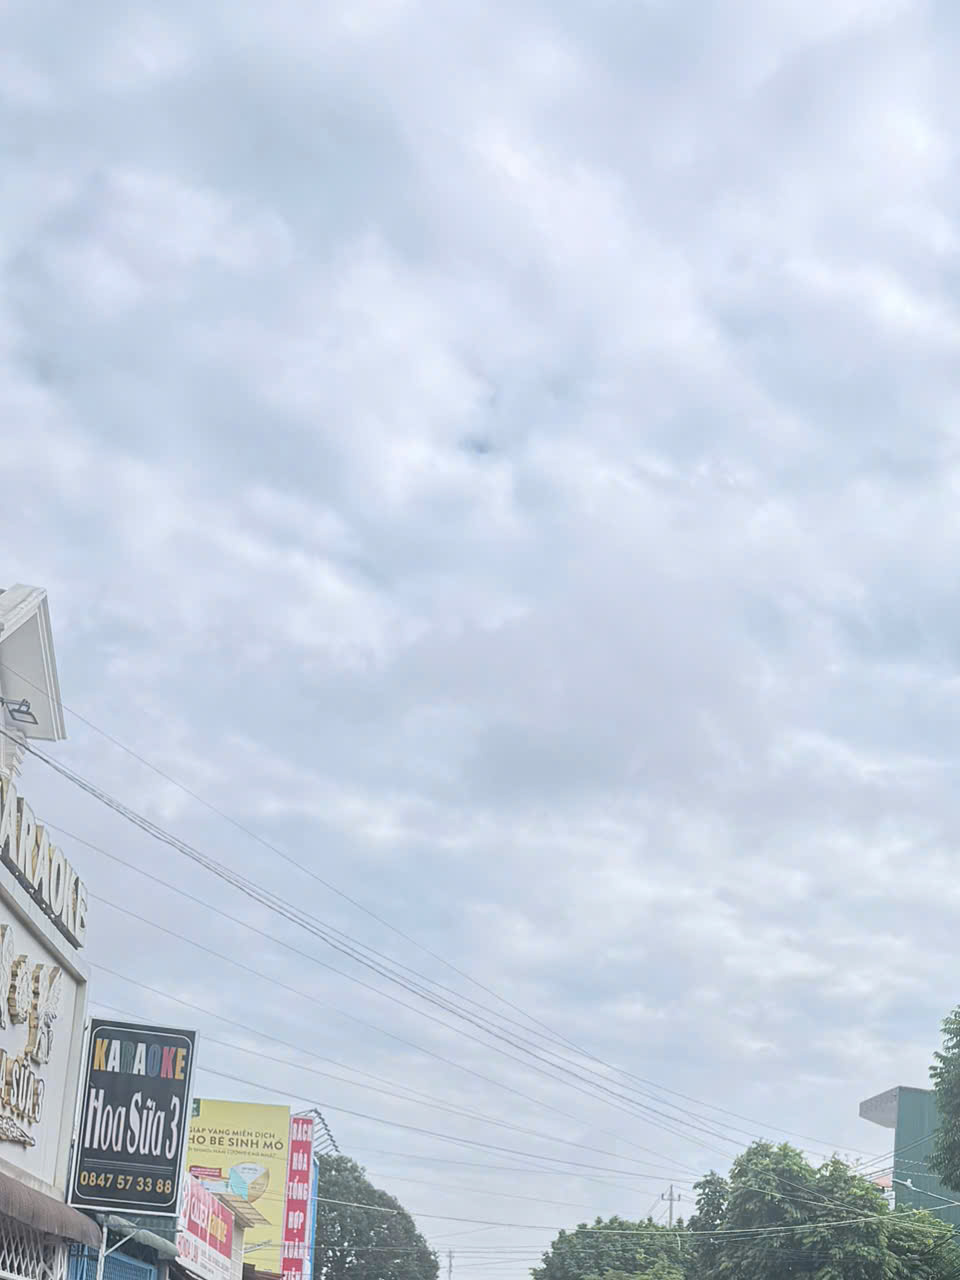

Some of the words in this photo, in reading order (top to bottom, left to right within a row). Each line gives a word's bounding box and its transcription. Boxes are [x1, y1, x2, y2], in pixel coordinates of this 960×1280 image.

[0, 780, 88, 948] ARAOKE
[93, 1038, 187, 1080] KARAOKE
[84, 1085, 126, 1152] Hoa
[127, 1091, 165, 1156] Sữa
[165, 1095, 180, 1160] 3
[189, 1134, 206, 1145] HO
[228, 1137, 259, 1149] SINH
[80, 1171, 113, 1188] 0847
[116, 1175, 132, 1190] 57
[136, 1178, 152, 1192] 33
[155, 1179, 172, 1194] 88
